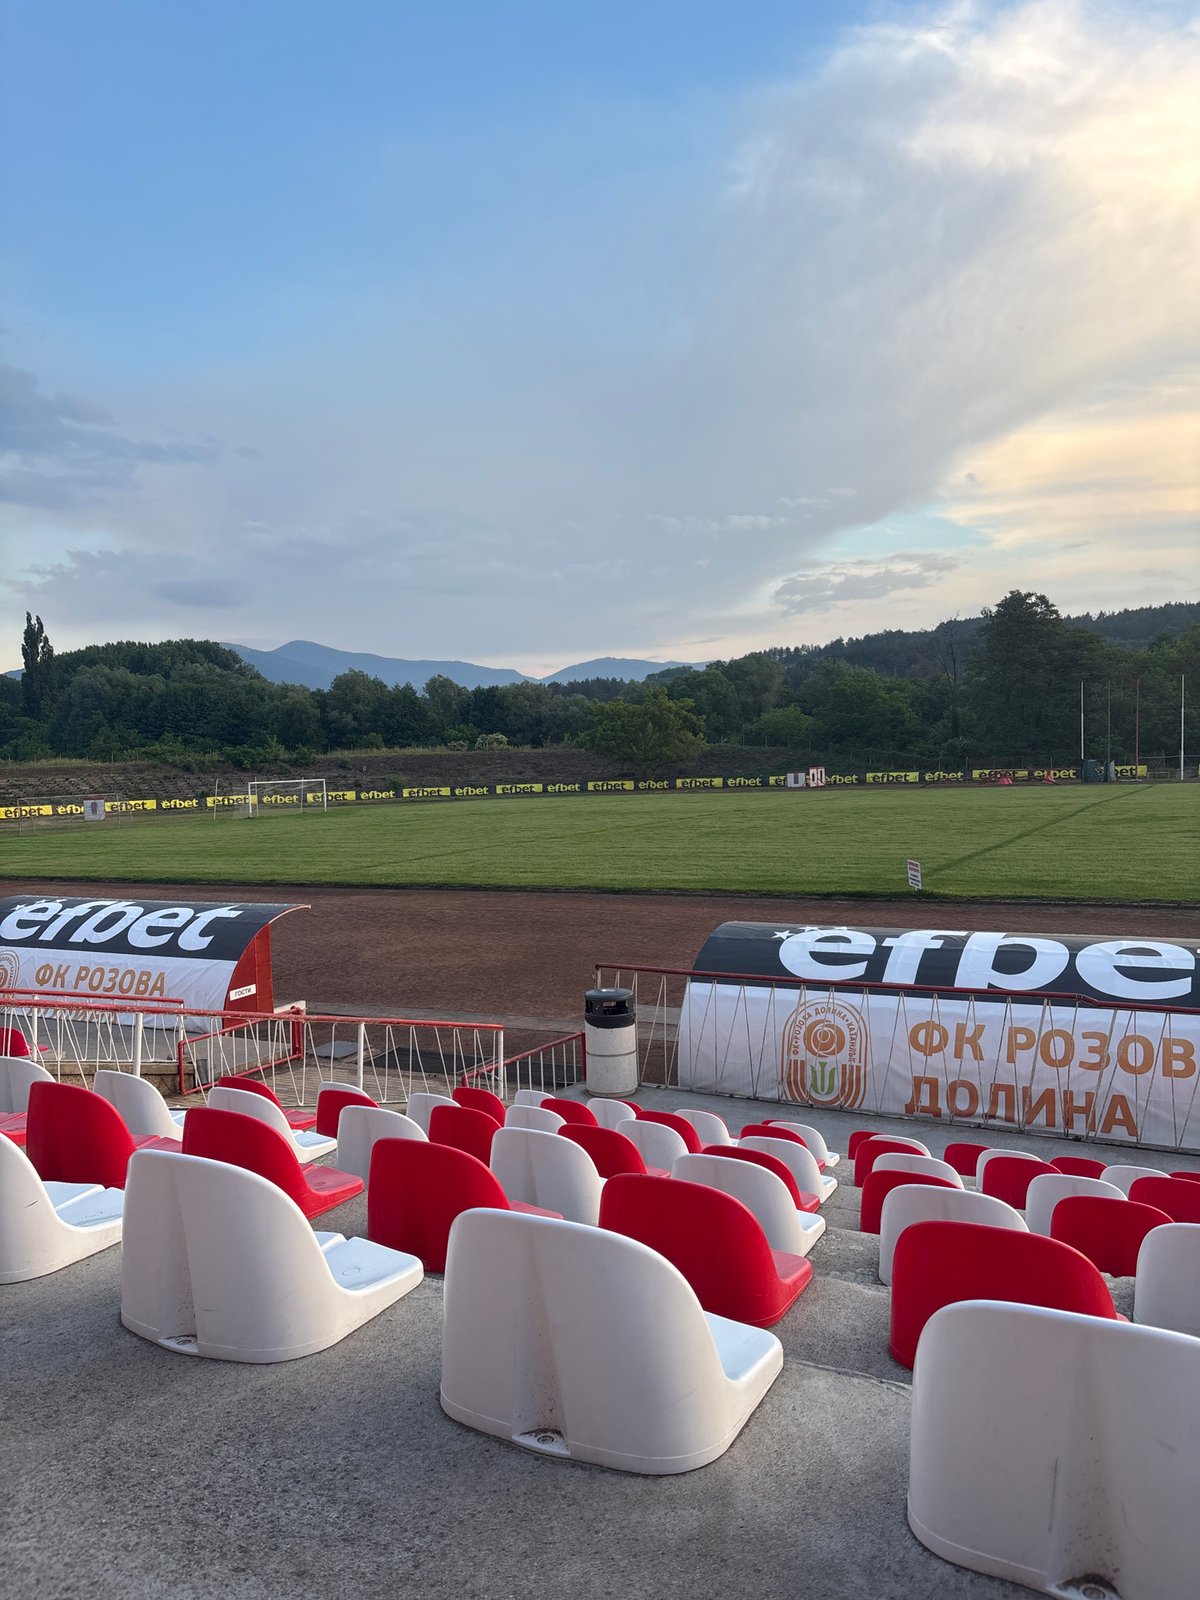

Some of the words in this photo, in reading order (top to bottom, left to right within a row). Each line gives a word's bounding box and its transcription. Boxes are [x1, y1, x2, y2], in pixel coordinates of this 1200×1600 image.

[727, 776, 762, 786] efbet
[872, 772, 910, 782] efbet
[547, 782, 581, 793] efbet
[593, 781, 626, 791] efbet
[638, 779, 669, 789] efbet
[682, 778, 715, 788] efbet
[408, 787, 442, 797] efbet
[454, 786, 489, 796] efbet
[501, 784, 535, 794] efbet
[263, 794, 299, 804] efbet
[312, 792, 347, 803] efbet
[360, 790, 396, 800] efbet
[111, 801, 147, 812] efbet
[161, 798, 198, 809] efbet
[4, 807, 44, 818] efbet
[58, 805, 84, 816] efb
[0, 898, 243, 950] efbet
[778, 929, 1200, 999] efbe
[35, 963, 71, 989] ФК
[74, 965, 166, 997] РОЗОВА
[234, 987, 252, 997] ГОСТИ
[909, 1020, 986, 1062] ФК
[1007, 1026, 1197, 1079] РОЗОВ
[904, 1075, 1139, 1137] ДОЛИНА
